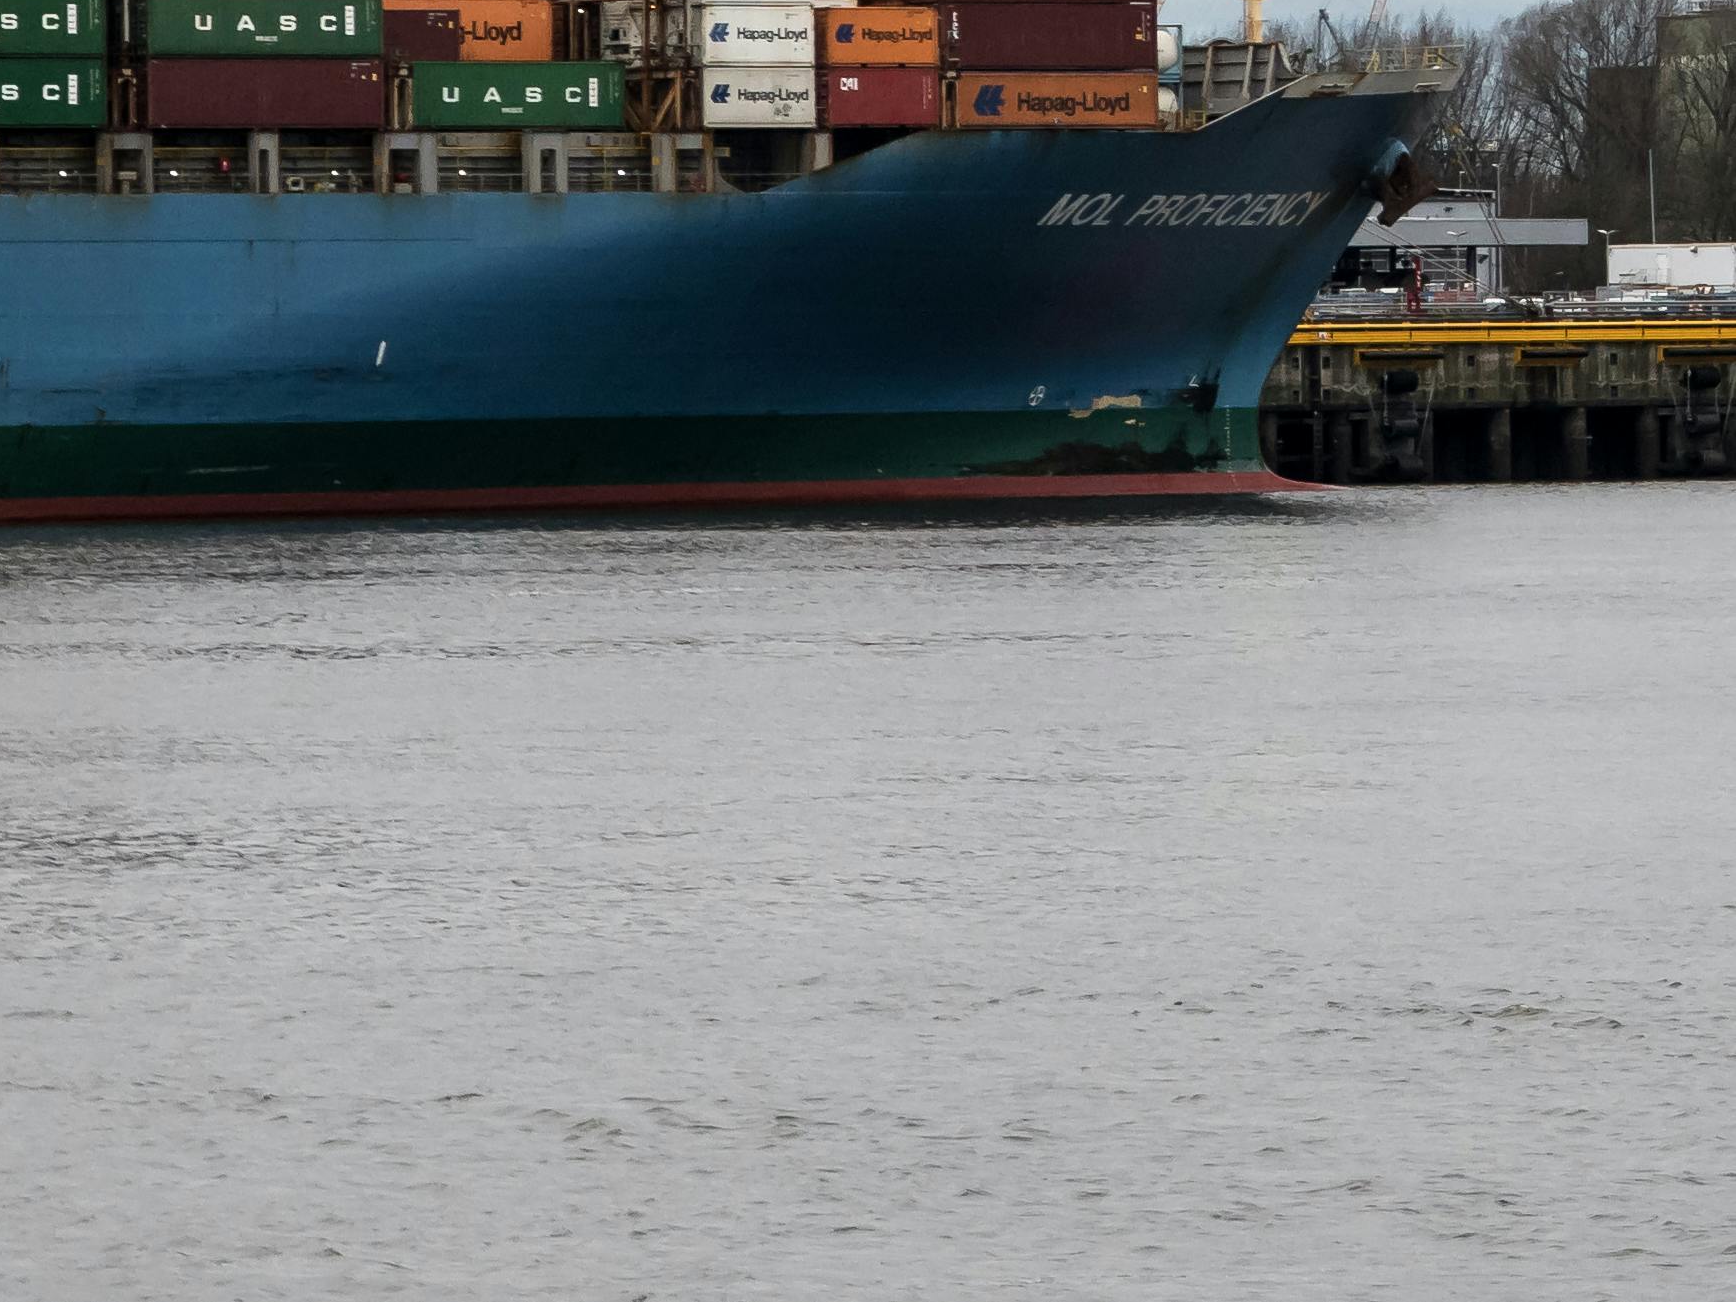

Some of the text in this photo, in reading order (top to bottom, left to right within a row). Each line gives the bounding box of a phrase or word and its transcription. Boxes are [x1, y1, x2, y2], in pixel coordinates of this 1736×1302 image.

[737, 28, 807, 42] Hapag-Lloyd
[862, 28, 932, 43] Hapag-Lloyd
[738, 89, 809, 103] Hapag-Lloyd
[1017, 91, 1131, 116] Hapag-Lloyd
[1037, 191, 1330, 226] MOL PROFICIENCY
